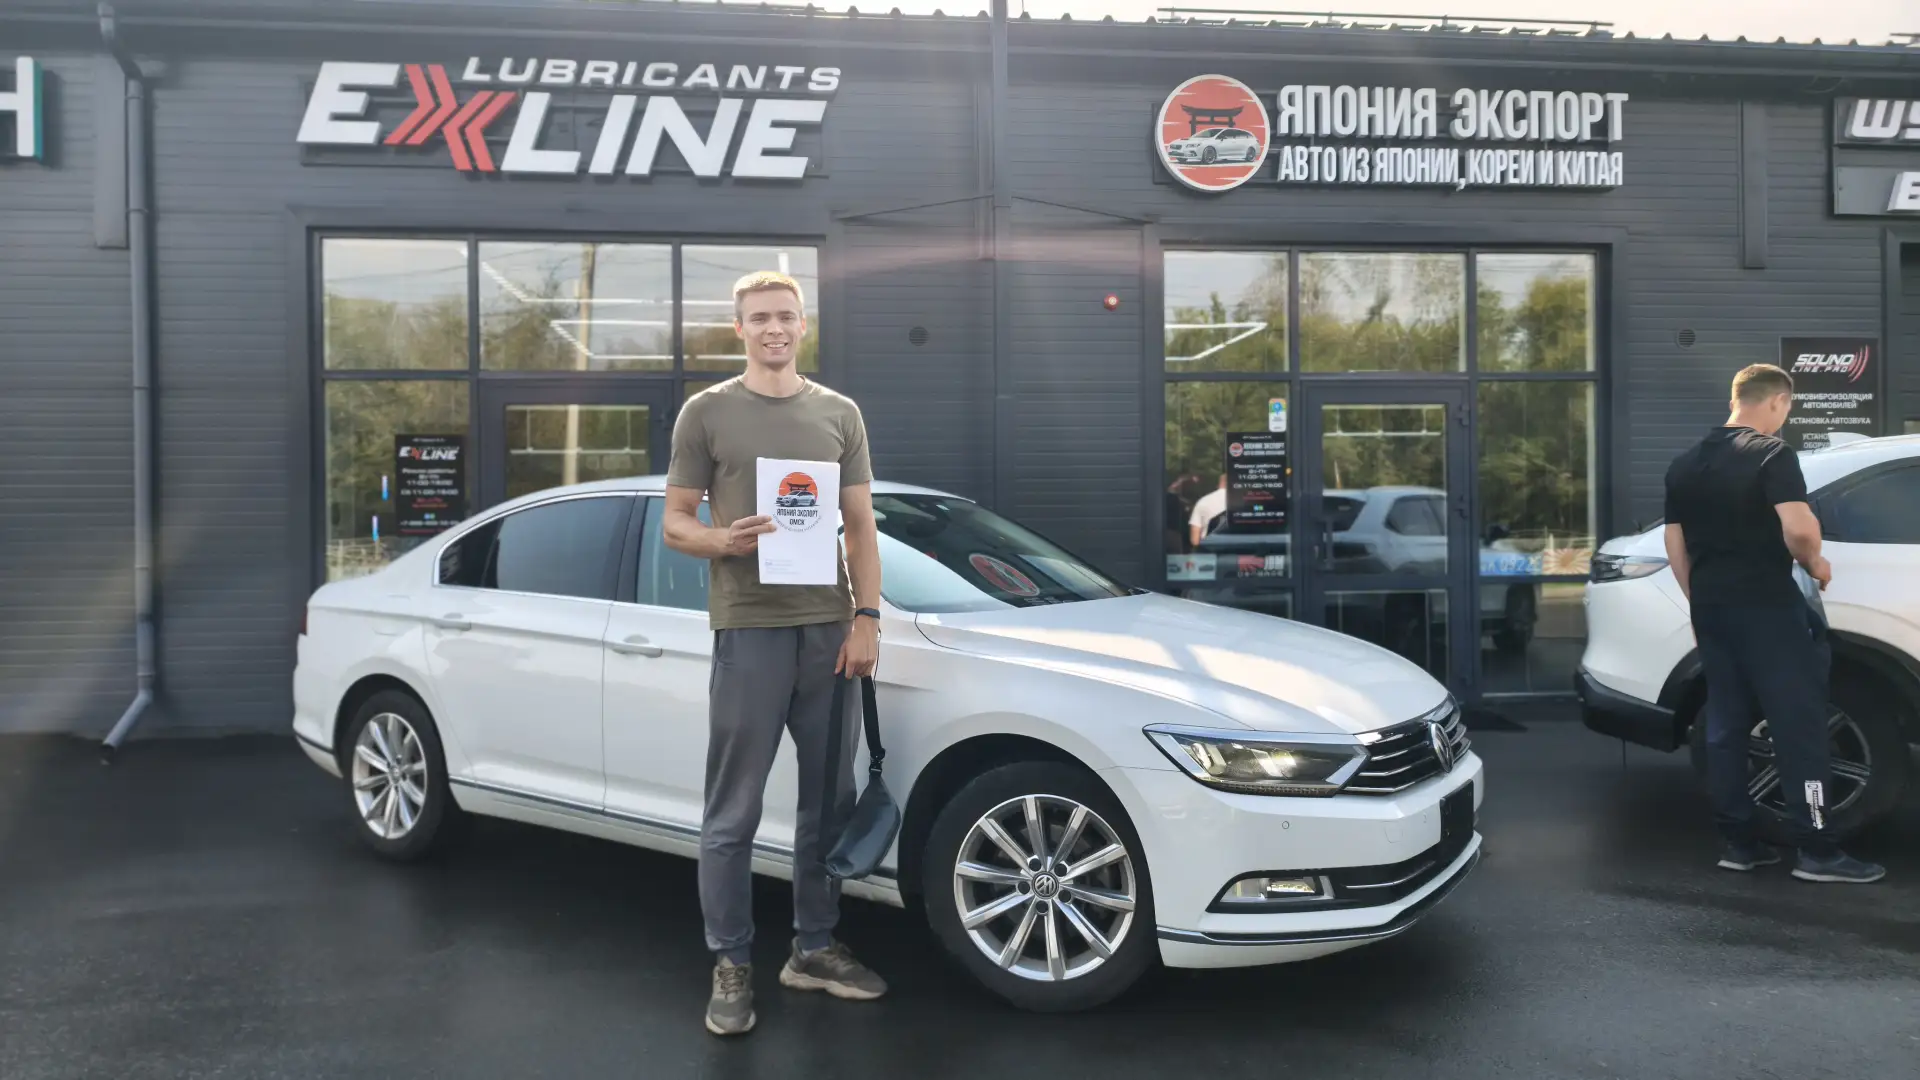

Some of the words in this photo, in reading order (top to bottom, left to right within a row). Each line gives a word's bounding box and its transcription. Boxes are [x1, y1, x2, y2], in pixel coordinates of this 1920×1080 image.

[462, 57, 842, 90] LUBRICANTS
[296, 62, 828, 178] EXLINE
[1277, 85, 1437, 138] ЯПОНИЯ
[1450, 88, 1629, 143] ЭКСПОРТ
[1278, 146, 1337, 182] АВТО
[1340, 147, 1370, 183] ИЗ
[1535, 150, 1554, 184] И
[1555, 151, 1624, 185] КИТАЯ
[1795, 354, 1855, 366] SOUND
[1803, 400, 1857, 409] АВТОМОБИЛЕЙ
[1789, 417, 1829, 425] УСТАНОВКА
[777, 508, 797, 517] ЯПОНИЯ
